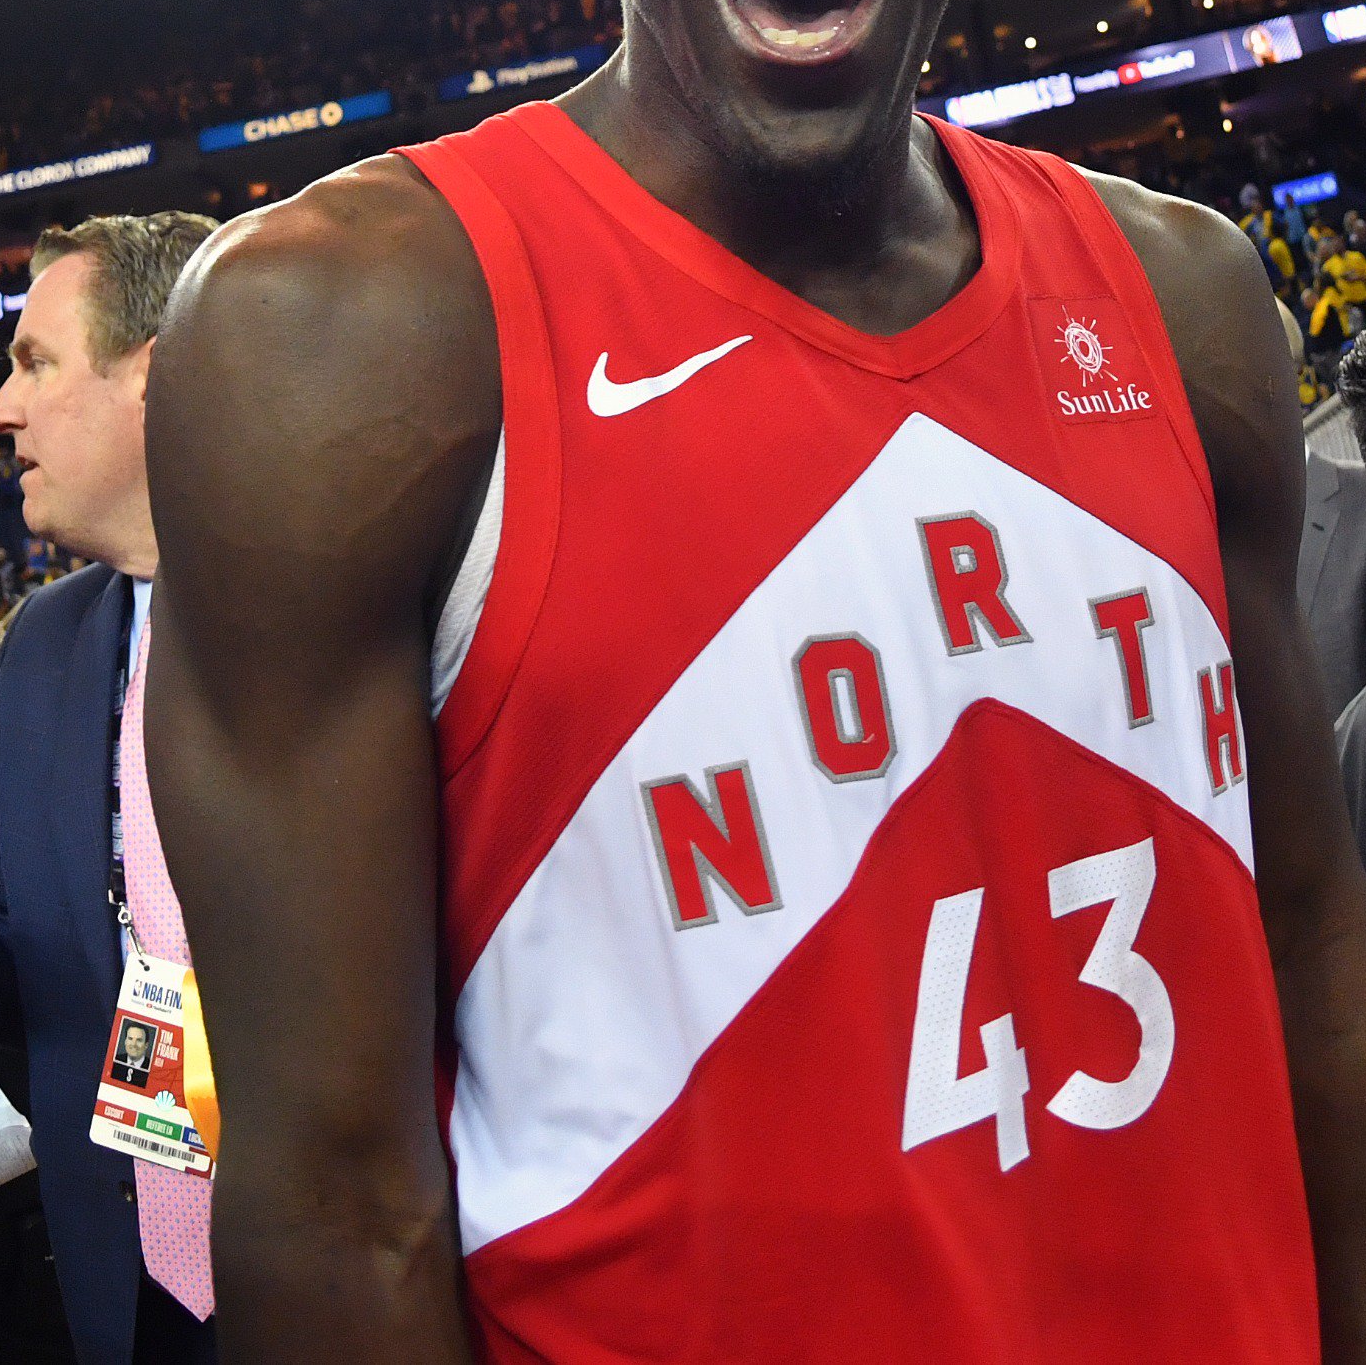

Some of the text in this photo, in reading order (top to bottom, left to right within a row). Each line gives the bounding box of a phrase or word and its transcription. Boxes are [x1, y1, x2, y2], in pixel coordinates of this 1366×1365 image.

[243, 108, 318, 142] CHASE
[639, 508, 1244, 932] NORTH
[141, 982, 163, 1004] NBA
[164, 988, 182, 1010] FIN
[900, 835, 1176, 1173] 43
[126, 1068, 134, 1082] S
